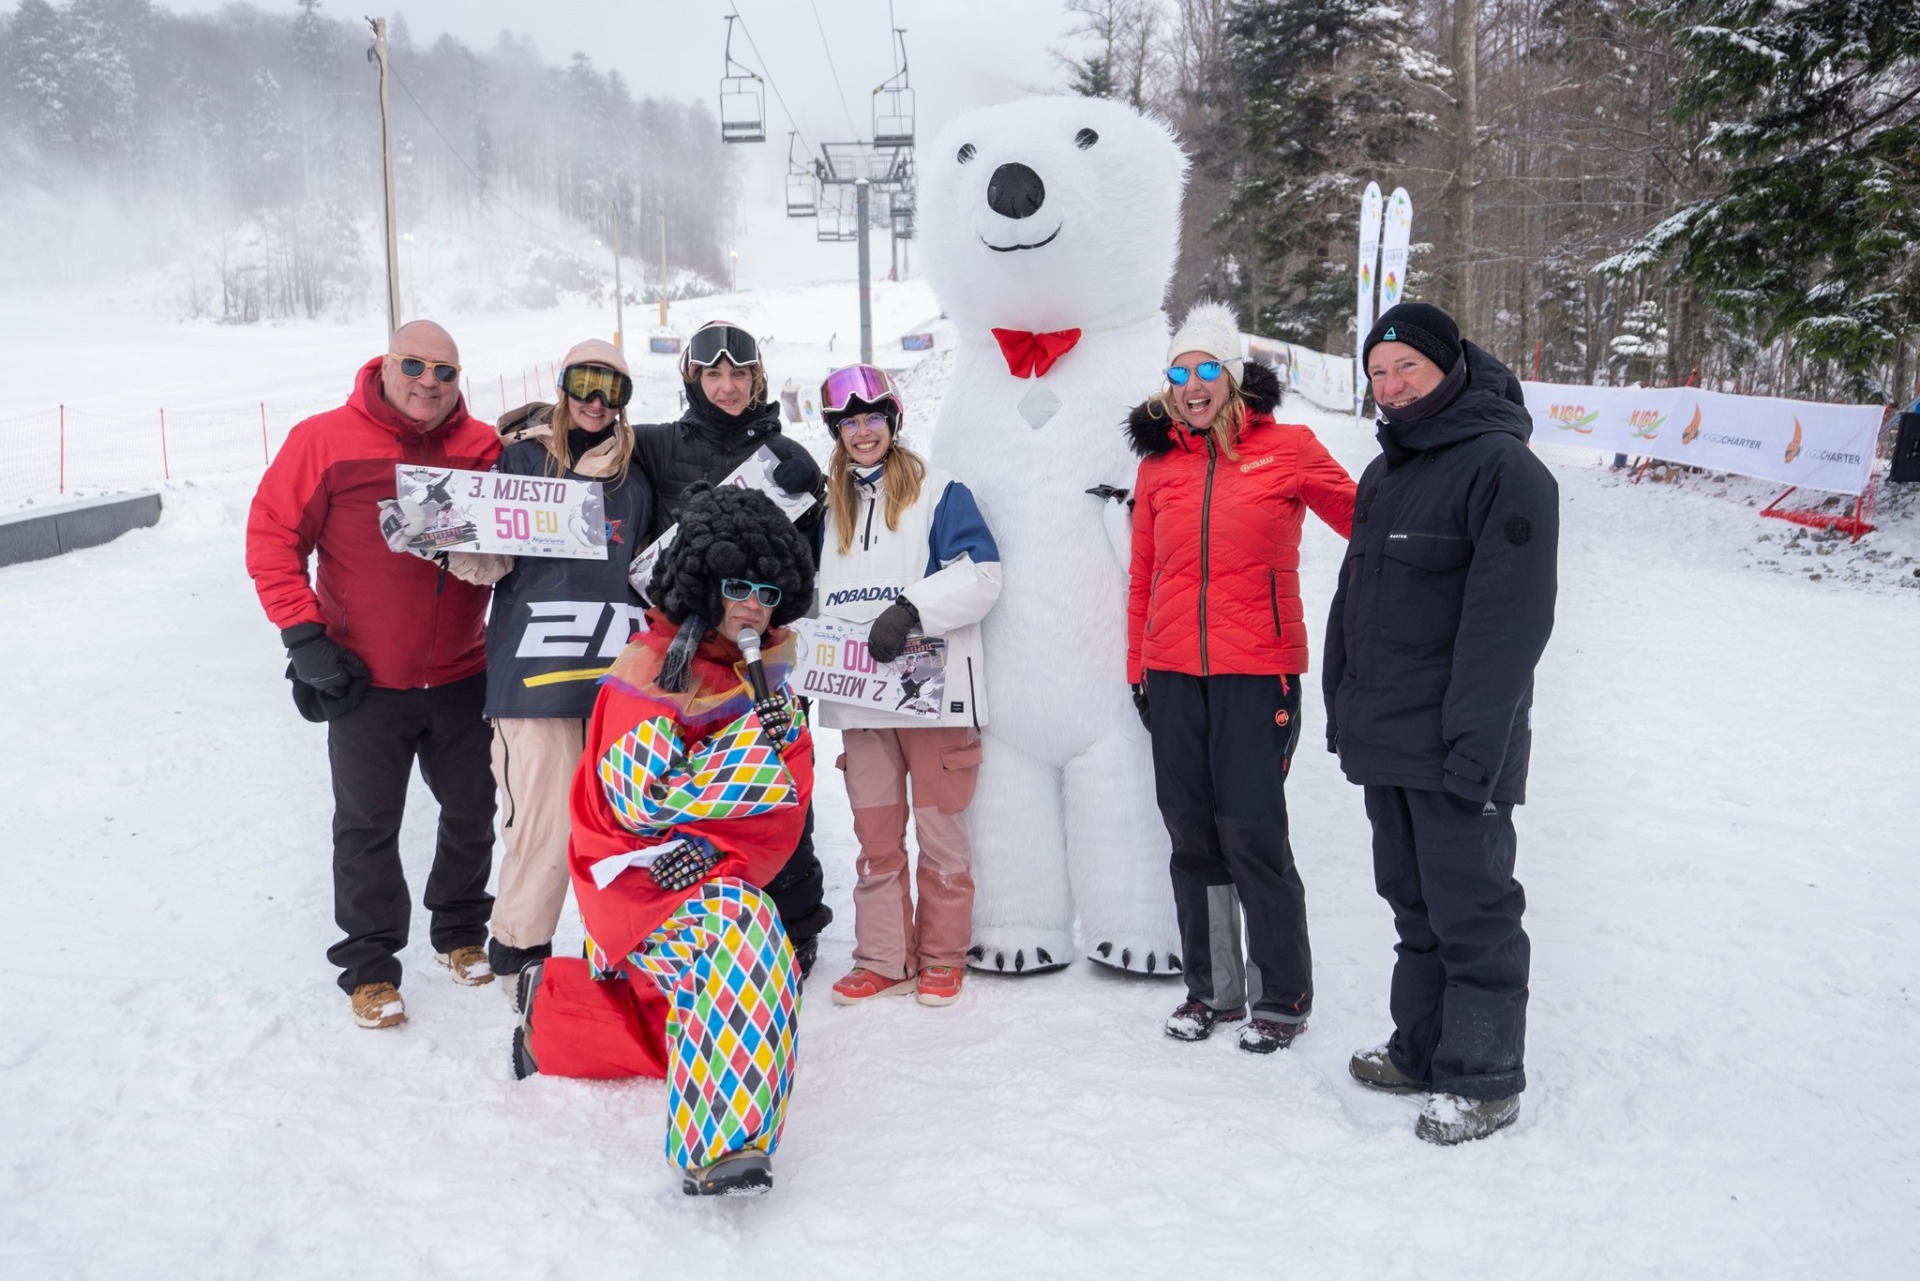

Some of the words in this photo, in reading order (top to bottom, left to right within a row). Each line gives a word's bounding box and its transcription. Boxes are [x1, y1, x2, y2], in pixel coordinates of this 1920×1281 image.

[1549, 404, 1585, 421] KIGO
[468, 475, 486, 499] 3.
[493, 478, 567, 504] MJESTO
[494, 506, 531, 541] 50
[535, 510, 559, 533] EU
[825, 586, 905, 606] NOBADAY
[816, 643, 836, 667] EU
[803, 669, 867, 699] MJESTO
[873, 680, 888, 702] 2.
